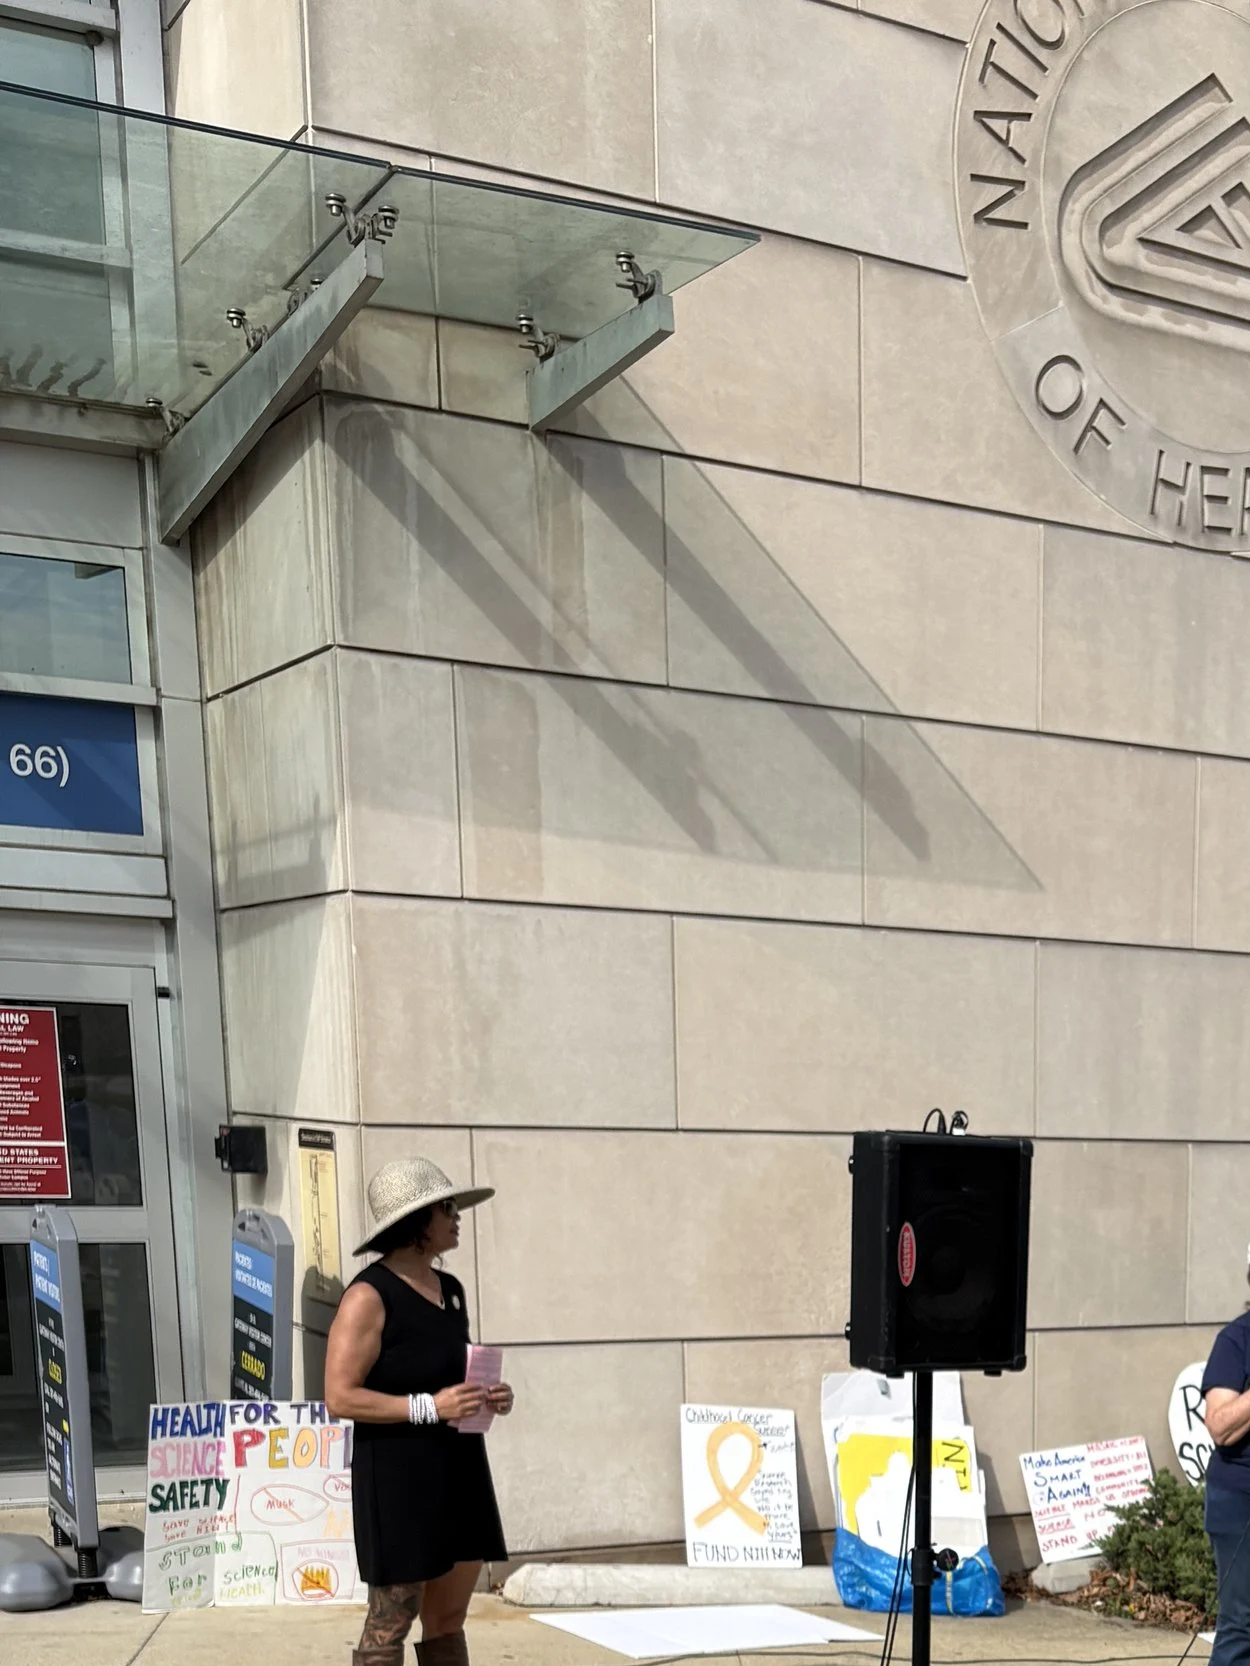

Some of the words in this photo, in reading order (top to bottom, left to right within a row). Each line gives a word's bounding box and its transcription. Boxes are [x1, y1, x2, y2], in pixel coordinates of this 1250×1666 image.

[969, 0, 1085, 231] NATIO
[1034, 354, 1126, 455] OF
[9, 744, 70, 787] 66)
[10, 1148, 39, 1156] STATES
[241, 1350, 266, 1380] CERRADO
[151, 1403, 226, 1440] HEALTH
[230, 1403, 281, 1426] FOR
[150, 1441, 227, 1478] SCIENCE
[1023, 1456, 1052, 1470] Make
[1054, 1452, 1086, 1467] America
[1034, 1469, 1082, 1487] SMART
[150, 1478, 230, 1513] SAFETY
[692, 1542, 739, 1563] FUND
[743, 1546, 769, 1561] NIH
[1042, 1535, 1078, 1552] STAND
